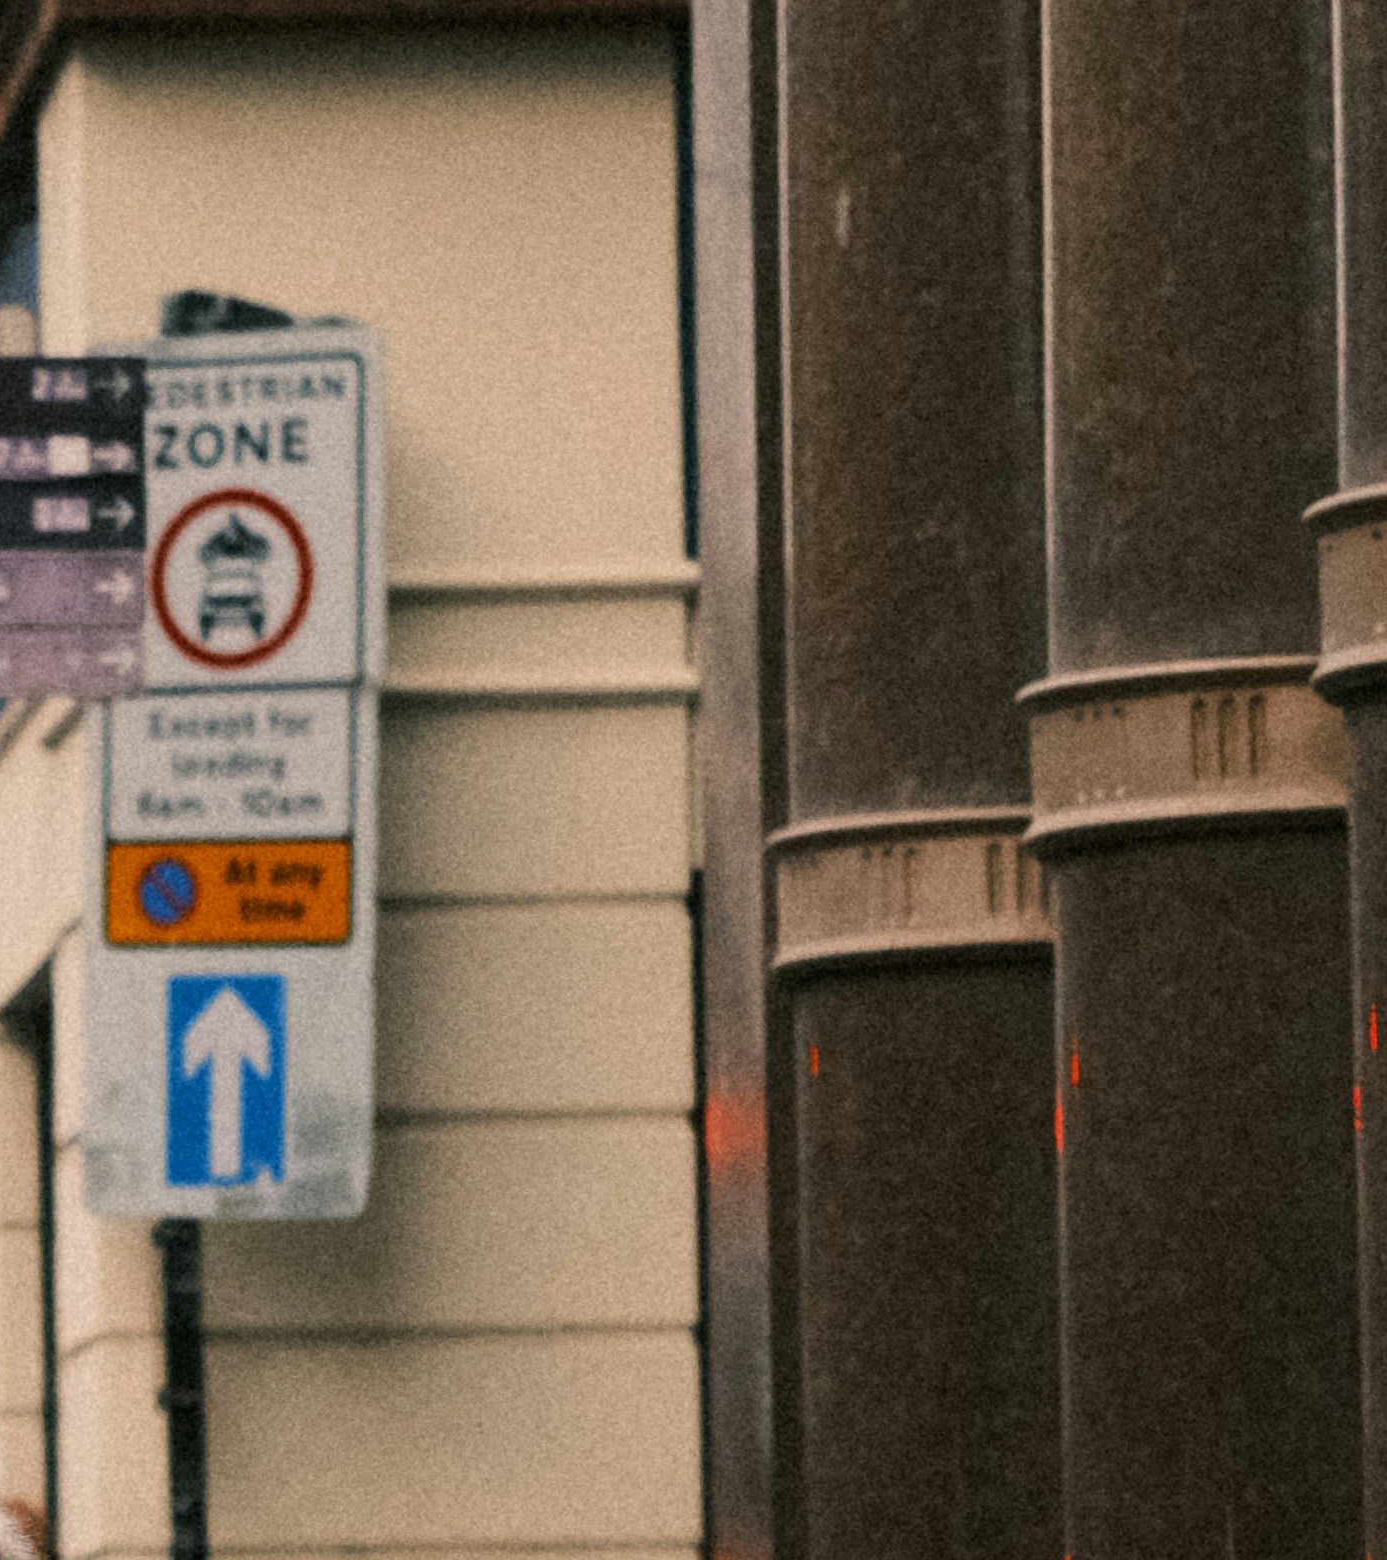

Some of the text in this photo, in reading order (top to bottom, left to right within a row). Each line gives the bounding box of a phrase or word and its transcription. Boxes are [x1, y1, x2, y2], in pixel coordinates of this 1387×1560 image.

[142, 374, 346, 408] EDESTRIAN
[153, 415, 308, 469] ZONE
[148, 710, 256, 741] Except
